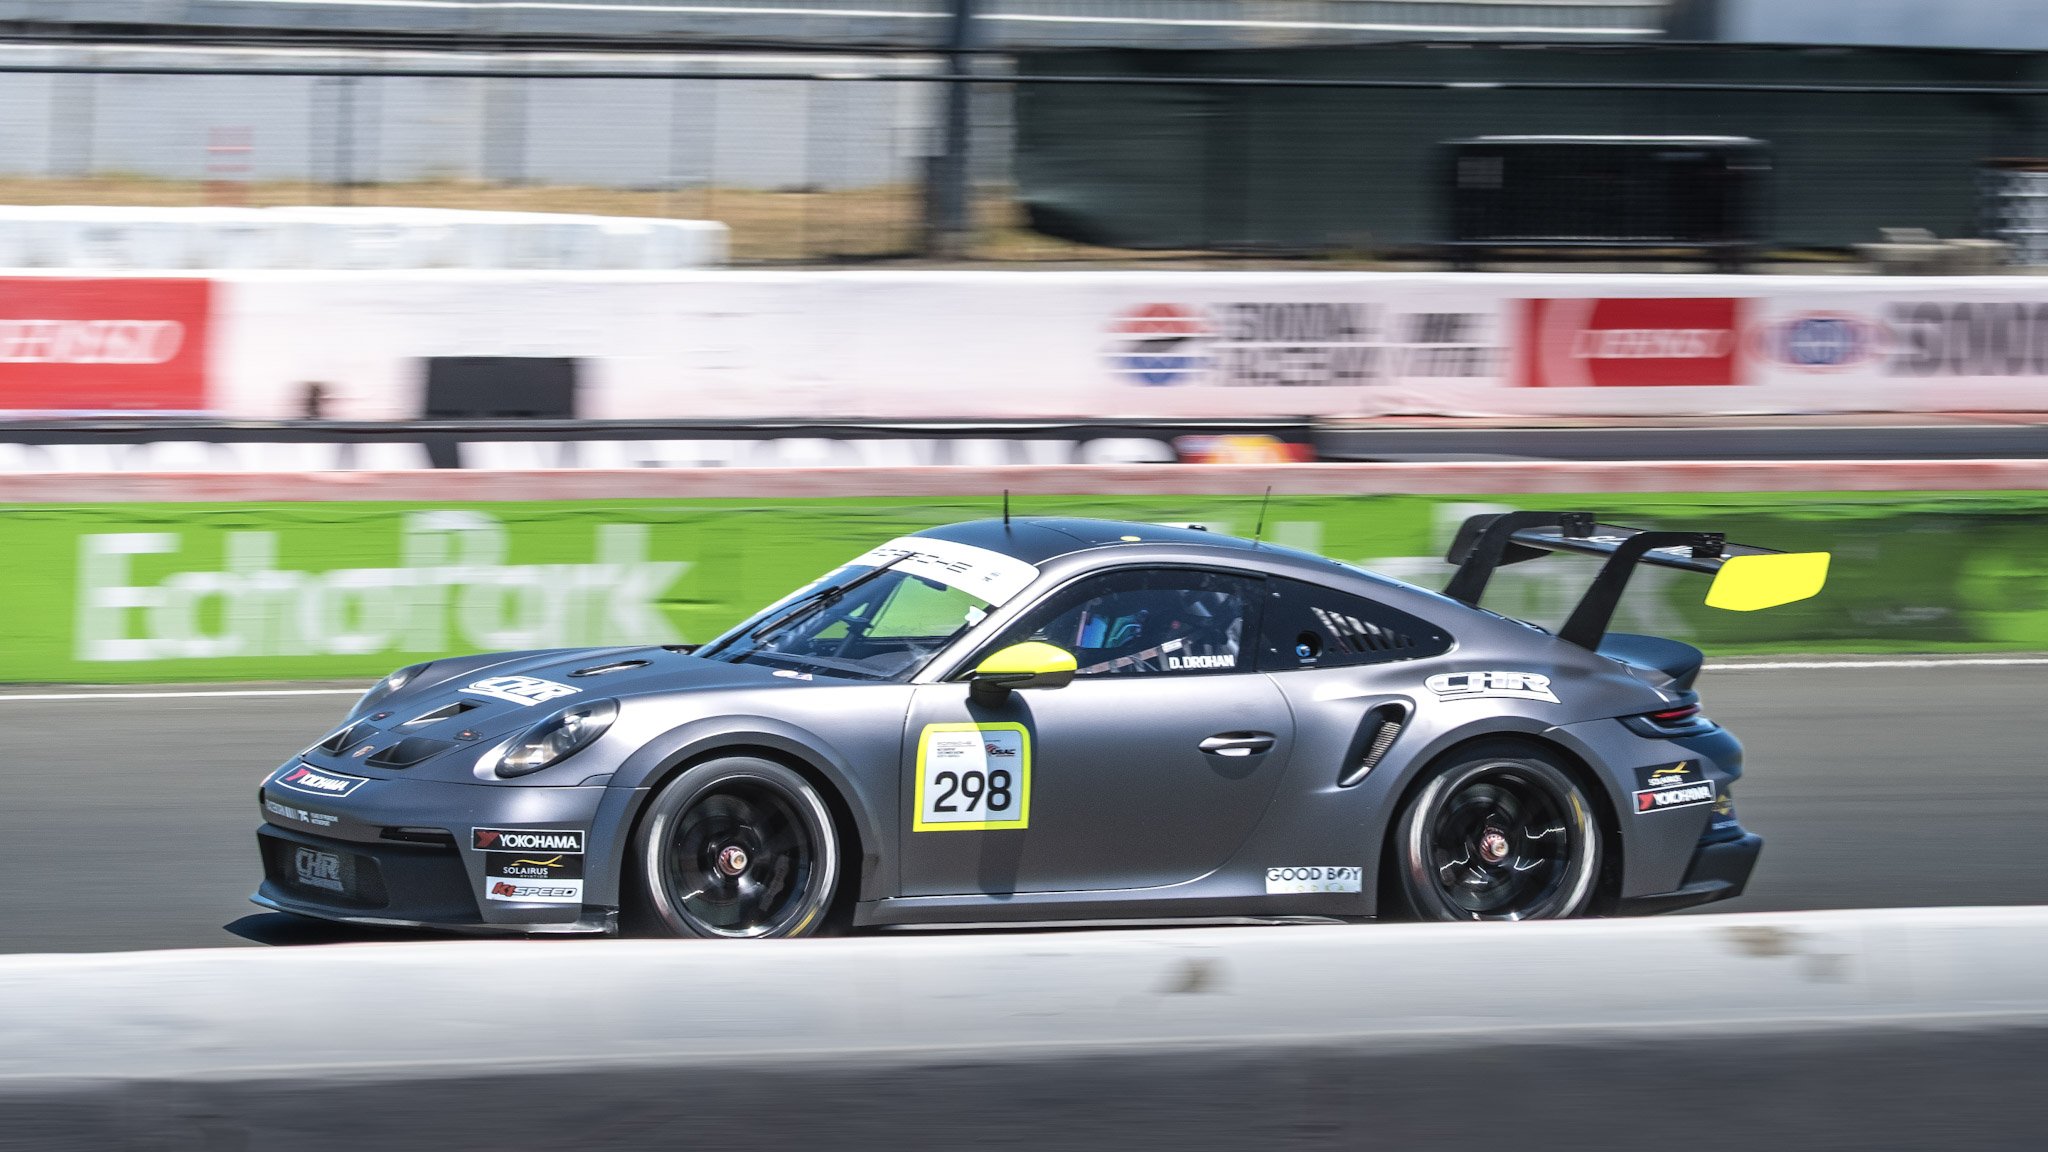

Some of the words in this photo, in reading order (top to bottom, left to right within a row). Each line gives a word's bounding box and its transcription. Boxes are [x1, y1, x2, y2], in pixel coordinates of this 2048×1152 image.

[75, 511, 692, 662] EchoPark
[934, 769, 1011, 812] 298
[498, 834, 579, 848] YOKOHAMA
[503, 866, 548, 875] SOLAIRUS
[1267, 868, 1321, 881] GOOD
[1327, 868, 1361, 881] BOY
